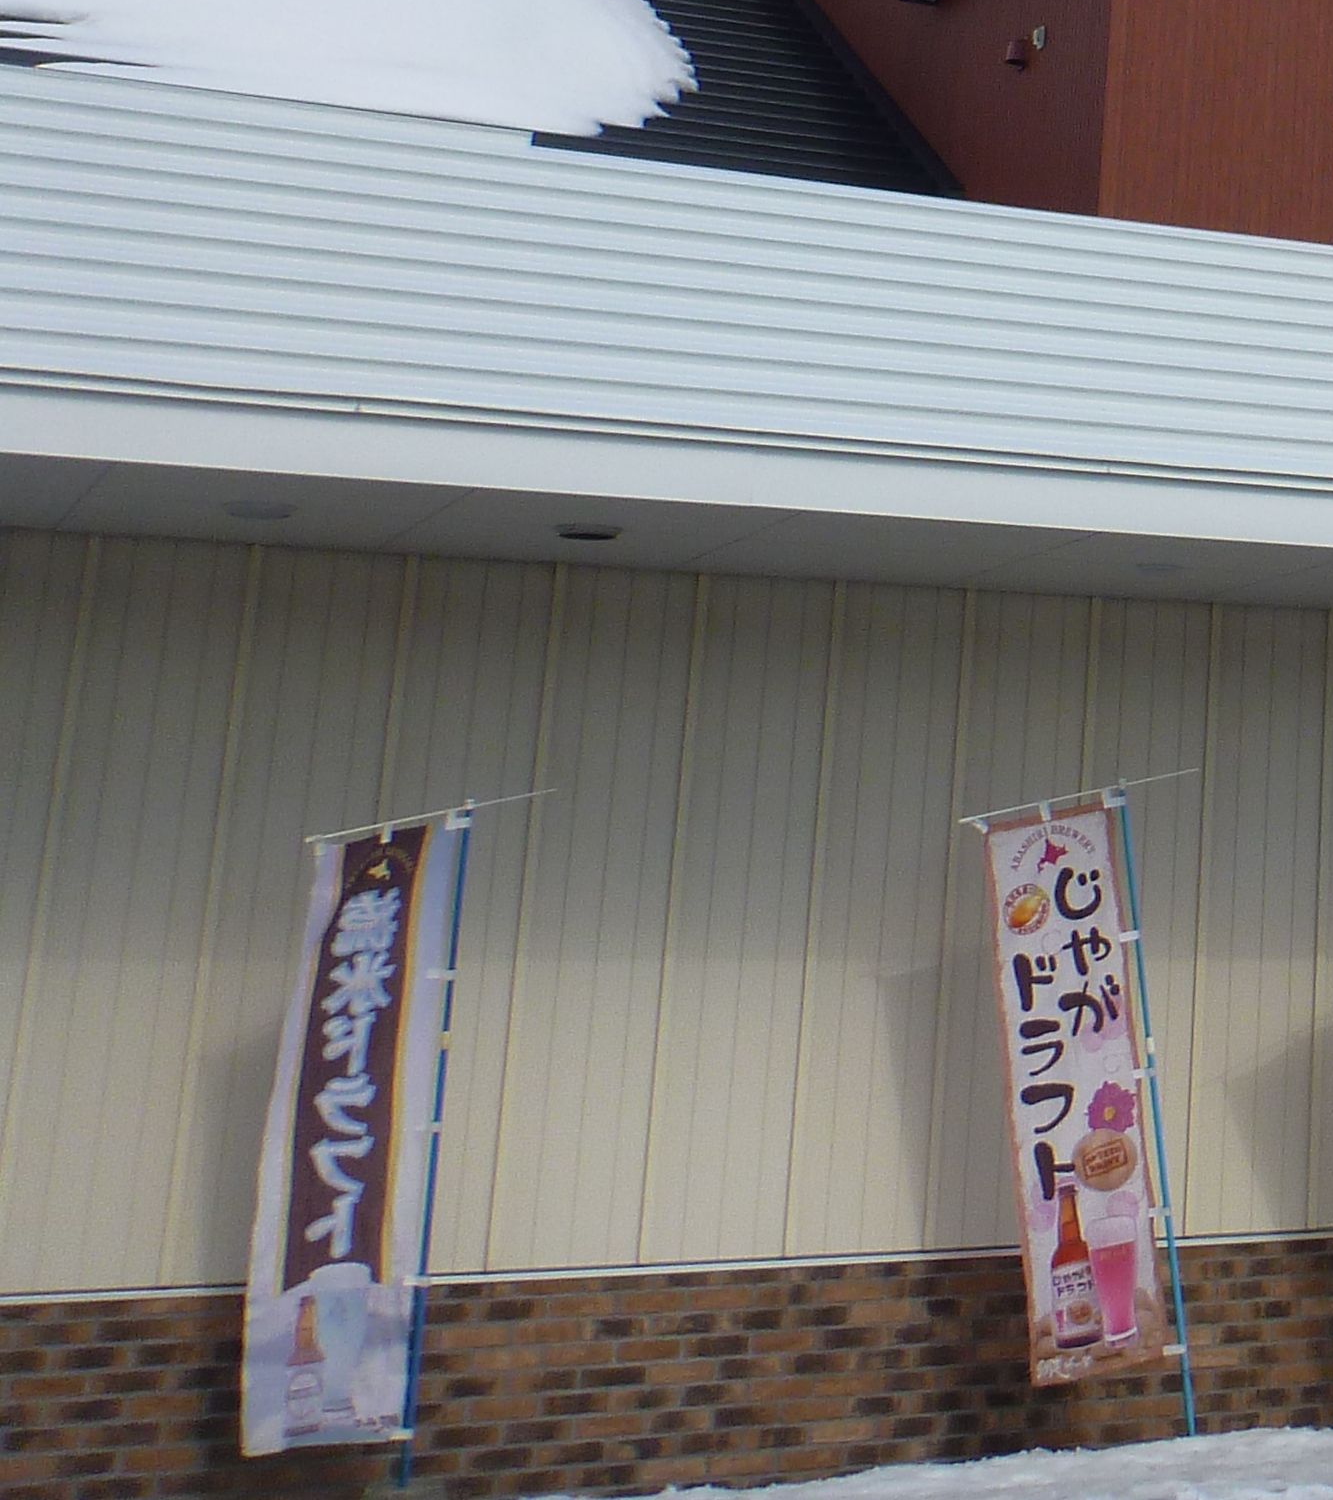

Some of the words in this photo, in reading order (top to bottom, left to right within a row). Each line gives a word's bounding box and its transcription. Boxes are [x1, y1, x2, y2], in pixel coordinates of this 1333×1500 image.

[1053, 866, 1121, 1038] じゃが
[1012, 951, 1076, 1202] ドラフト
